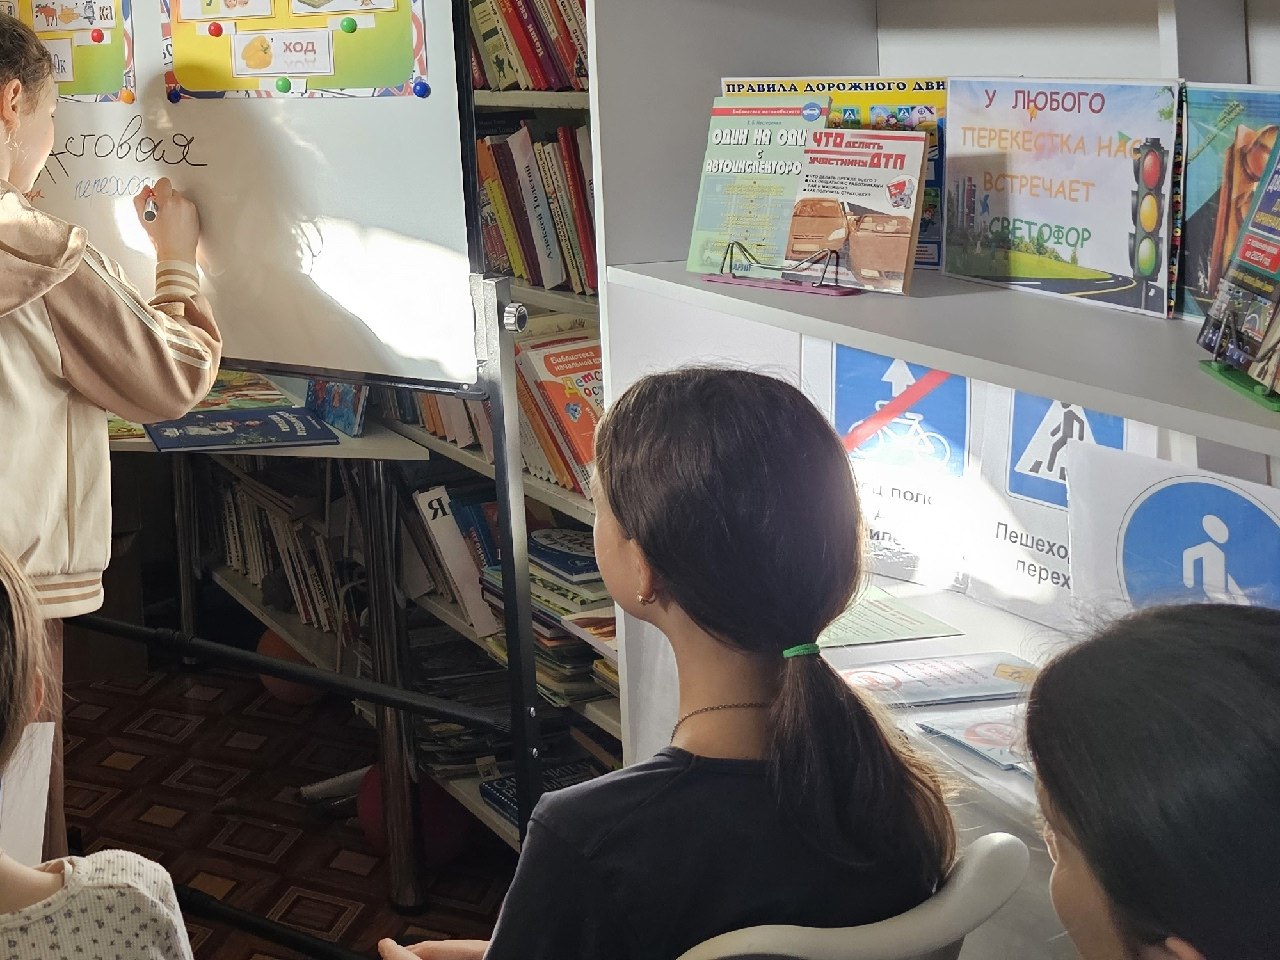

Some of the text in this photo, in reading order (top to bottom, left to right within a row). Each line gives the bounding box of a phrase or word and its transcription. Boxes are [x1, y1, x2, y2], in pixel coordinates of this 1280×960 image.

[726, 80, 947, 93] ПРАВИЛА ДОРОЖНОГО ДВИ
[984, 89, 1106, 114] У ЛЮБОГО
[65, 115, 208, 167] стовая
[712, 128, 809, 147] ОДИН НА ОДИ
[812, 131, 884, 150] ЧТО ДЕЛАТЬ
[961, 126, 1142, 161] ПЕРЕКЕСТКА НАС
[706, 160, 803, 176] АВТОИНСПЕКТОРО
[808, 152, 906, 171] УЧАСТНИКУ ДТП
[75, 175, 155, 208] перехо
[983, 171, 1096, 203] ВСТРЕЧАЕТ
[525, 165, 553, 260] Алексей Толстой
[988, 216, 1092, 249] СВЕТОФОР
[549, 351, 595, 365] Библиотека
[554, 360, 593, 372] начальной
[562, 370, 603, 399] Детс
[427, 496, 450, 521] Я
[995, 521, 1070, 559] Пешехо
[1015, 559, 1071, 590] перех
